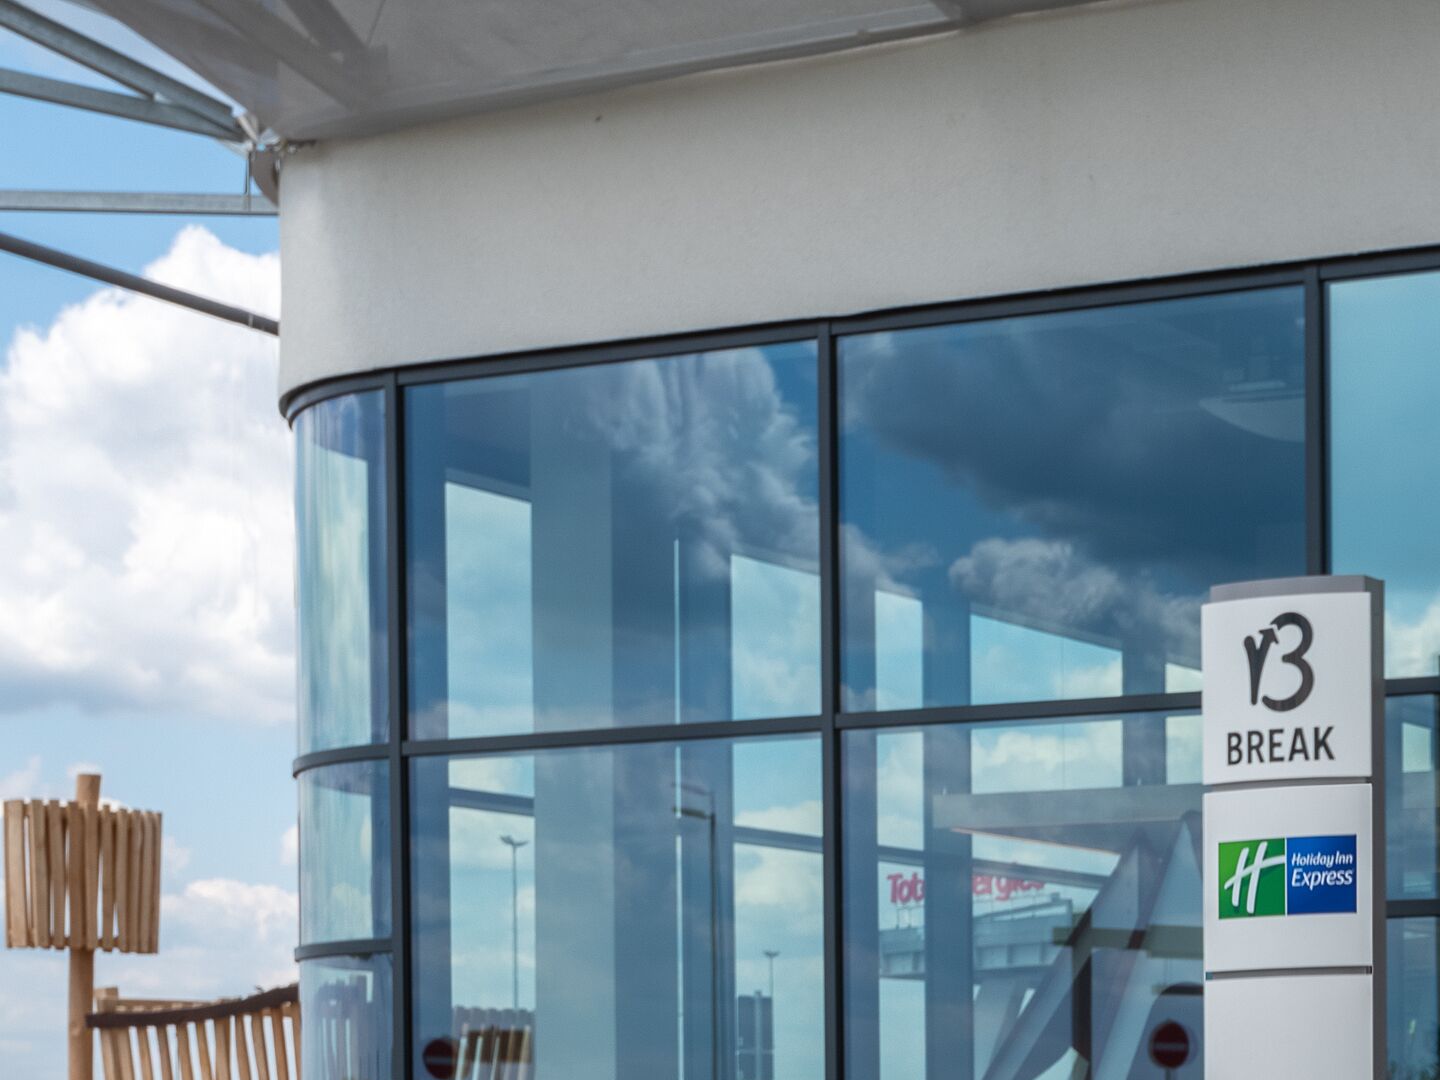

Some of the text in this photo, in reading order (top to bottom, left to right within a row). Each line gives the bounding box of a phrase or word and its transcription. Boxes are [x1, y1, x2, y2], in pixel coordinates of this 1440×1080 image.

[1227, 725, 1335, 766] BREAK
[1291, 850, 1353, 868] Holiday Inn
[1291, 868, 1353, 891] Express
